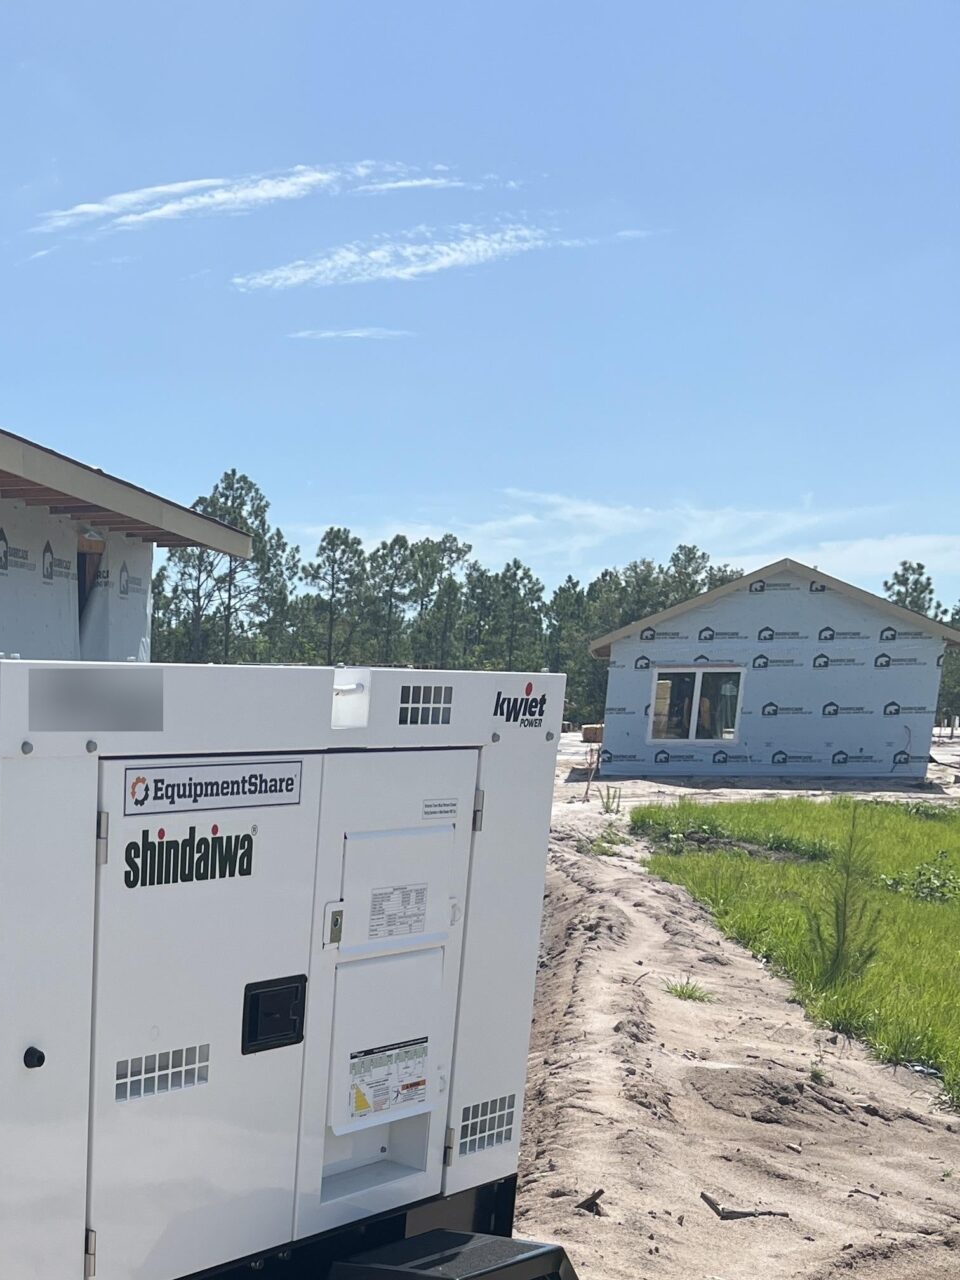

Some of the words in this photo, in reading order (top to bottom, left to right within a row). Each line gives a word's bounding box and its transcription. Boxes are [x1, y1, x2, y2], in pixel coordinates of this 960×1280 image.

[493, 682, 547, 722] kwiet
[520, 718, 543, 728] POWER
[153, 774, 294, 804] EquipmentShare
[124, 824, 253, 888] shindaiwa
